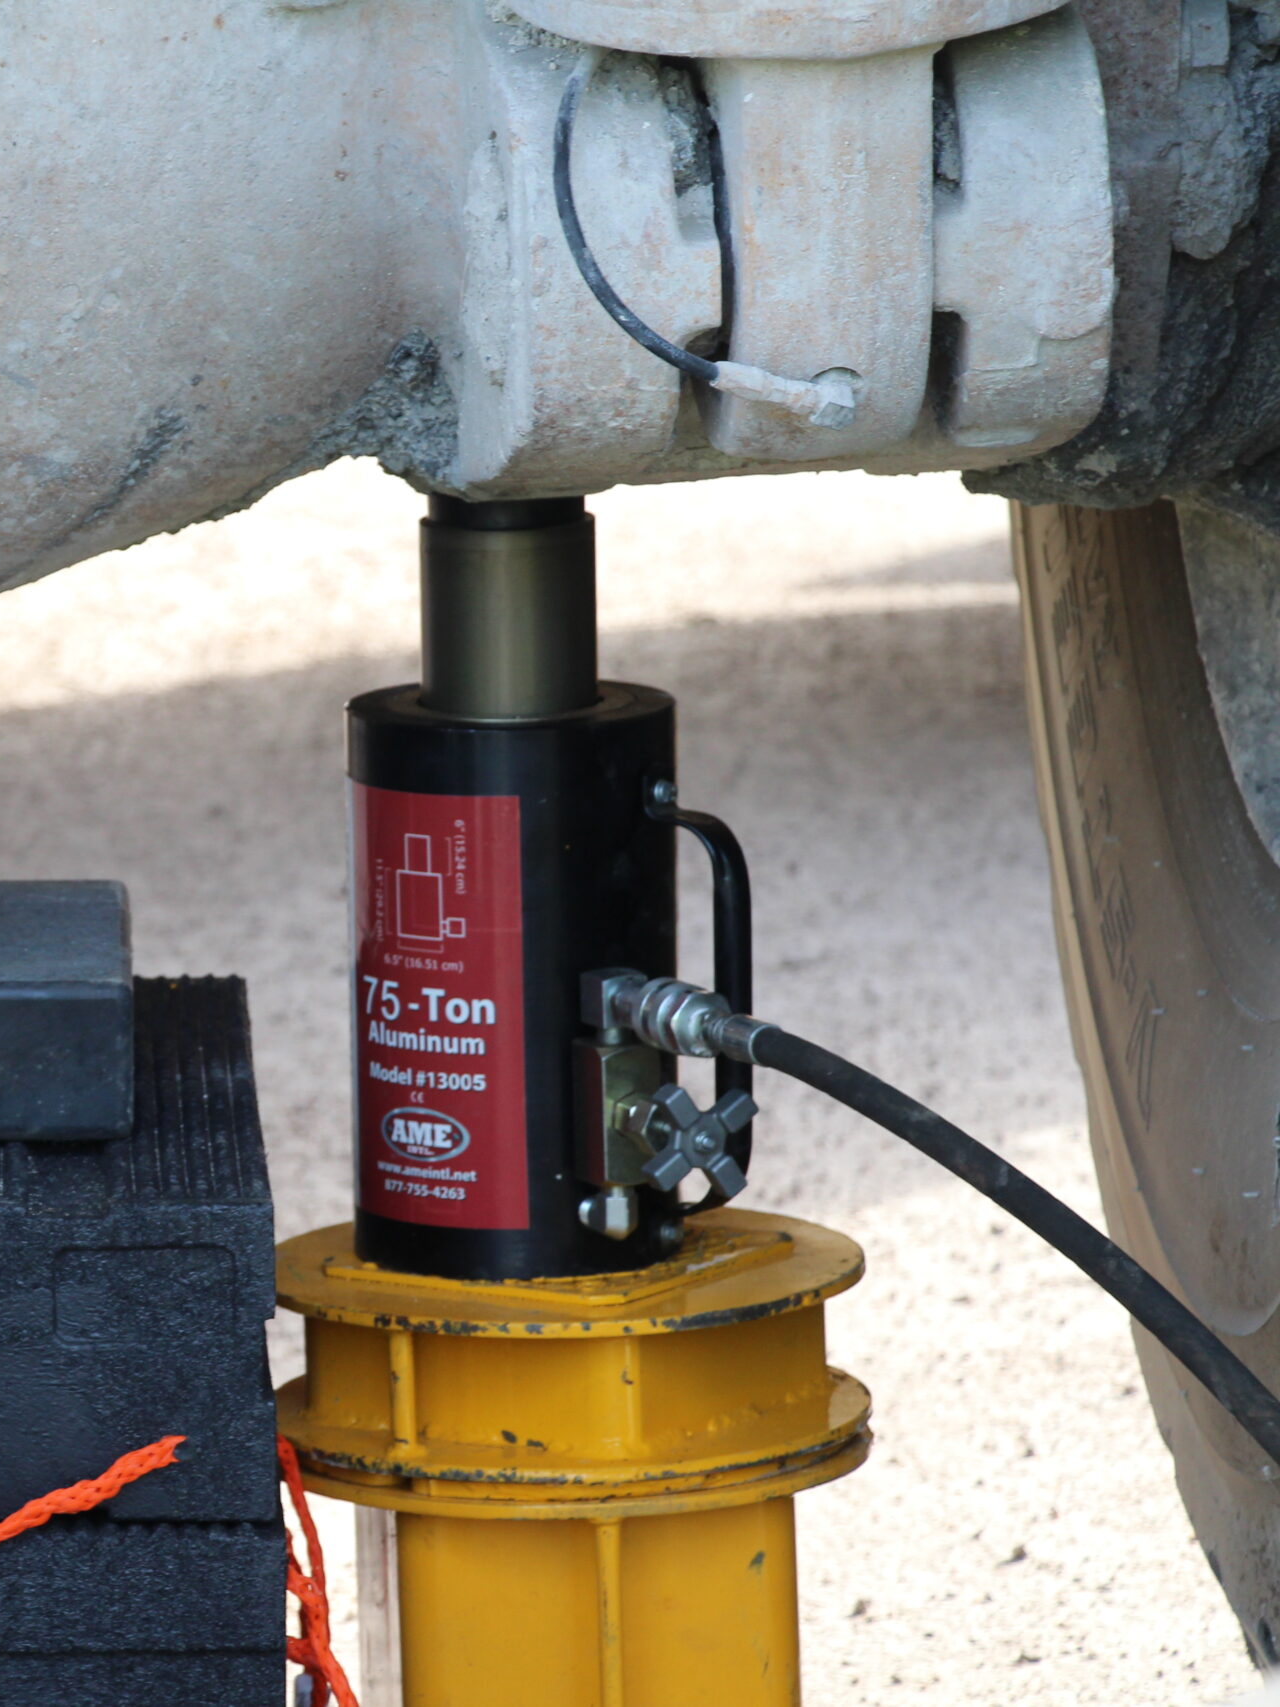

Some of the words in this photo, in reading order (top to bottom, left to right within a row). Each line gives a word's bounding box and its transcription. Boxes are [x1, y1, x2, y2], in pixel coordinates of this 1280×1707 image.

[455, 872, 467, 895] cm)
[441, 960, 464, 973] cm)
[368, 1020, 486, 1056] Aluminum
[369, 1061, 413, 1086] Model
[415, 1071, 487, 1092] #13005
[391, 1118, 453, 1149] AME
[377, 1160, 478, 1183] www.ameintl.net
[384, 1178, 467, 1201] 877-755-4263
